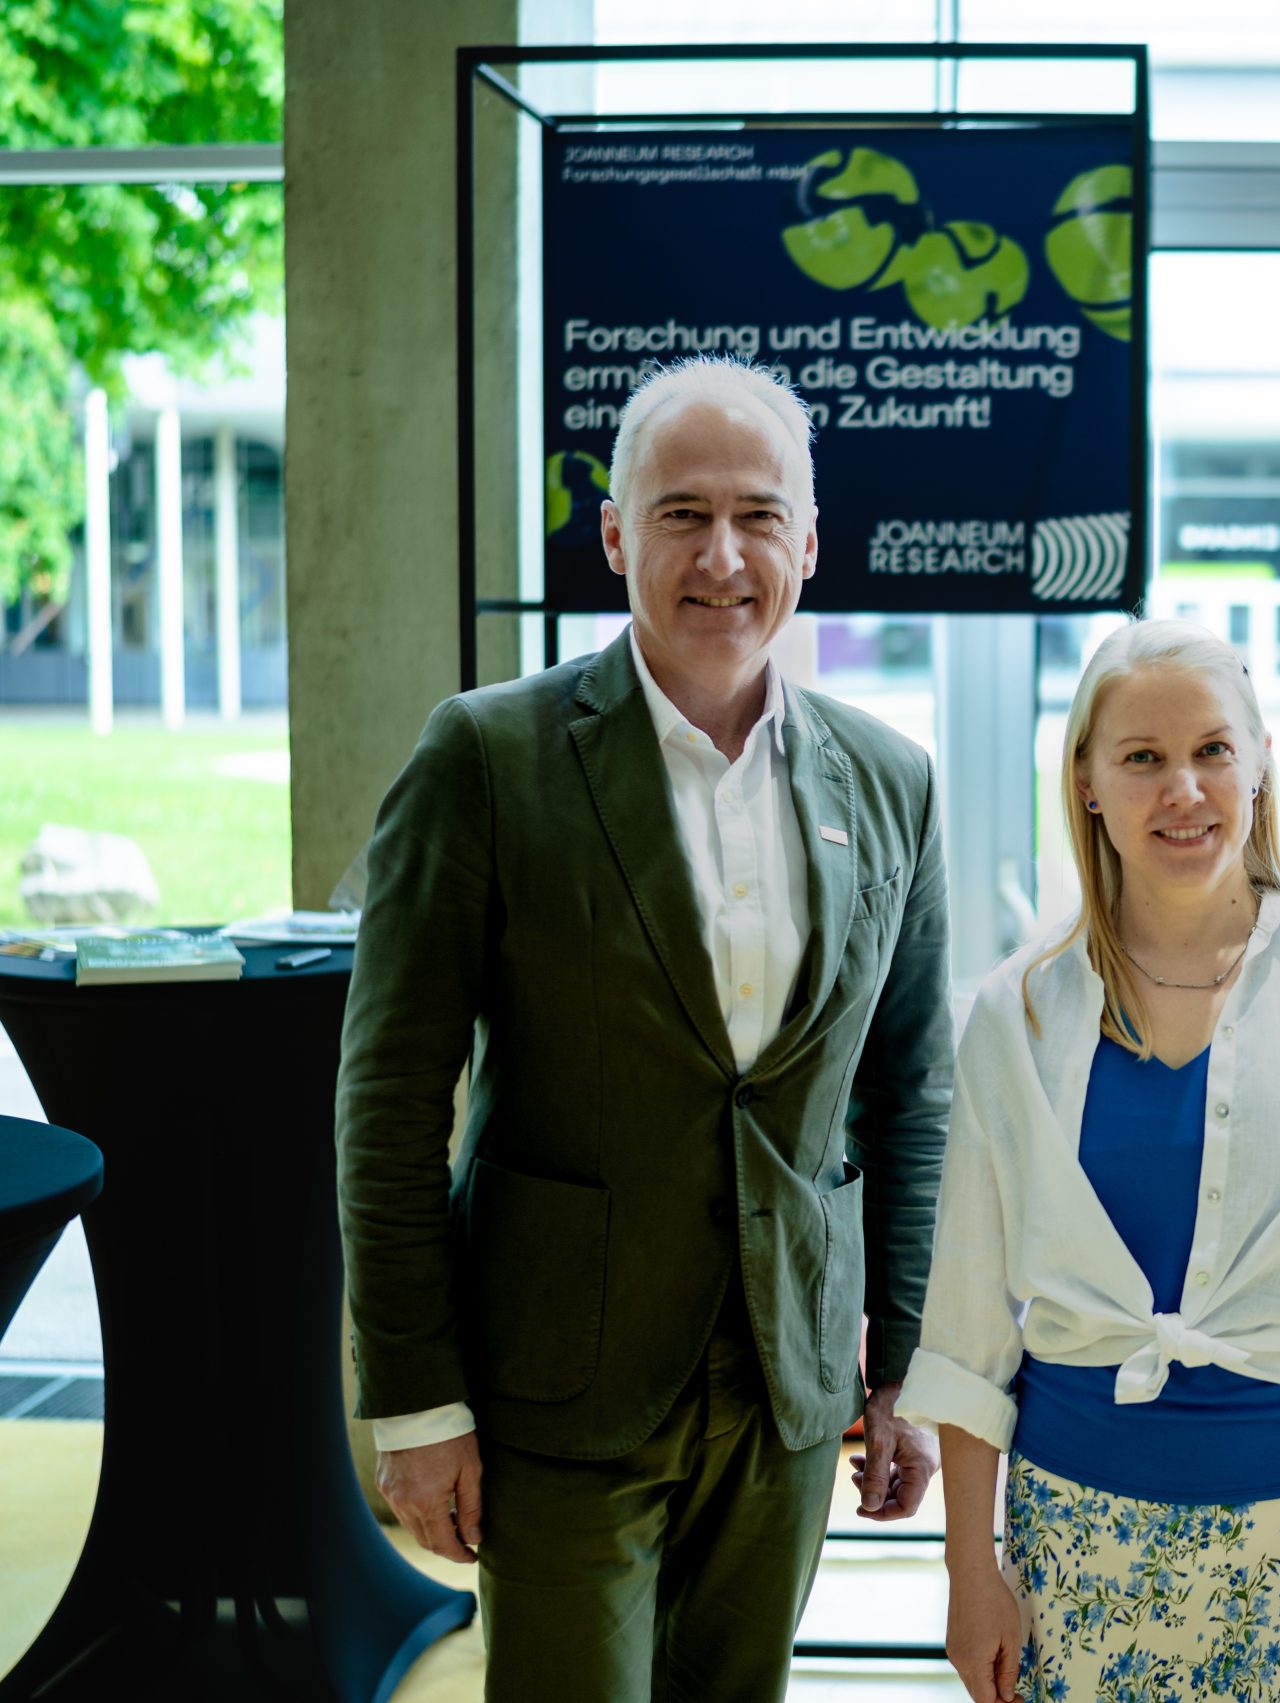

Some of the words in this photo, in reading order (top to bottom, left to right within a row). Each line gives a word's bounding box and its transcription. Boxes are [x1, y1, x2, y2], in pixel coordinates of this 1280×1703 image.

[564, 145, 658, 163] JOANNEUM
[660, 144, 755, 162] RESEARCH
[564, 318, 760, 357] Forschung
[769, 319, 841, 351] und
[850, 317, 1081, 358] Entwicklung
[800, 357, 858, 390] die
[865, 356, 1073, 398] Gestaltung
[837, 396, 992, 429] Zukunft!
[869, 519, 1025, 547] JOANNEUM
[869, 546, 1025, 574] RESEARCH
